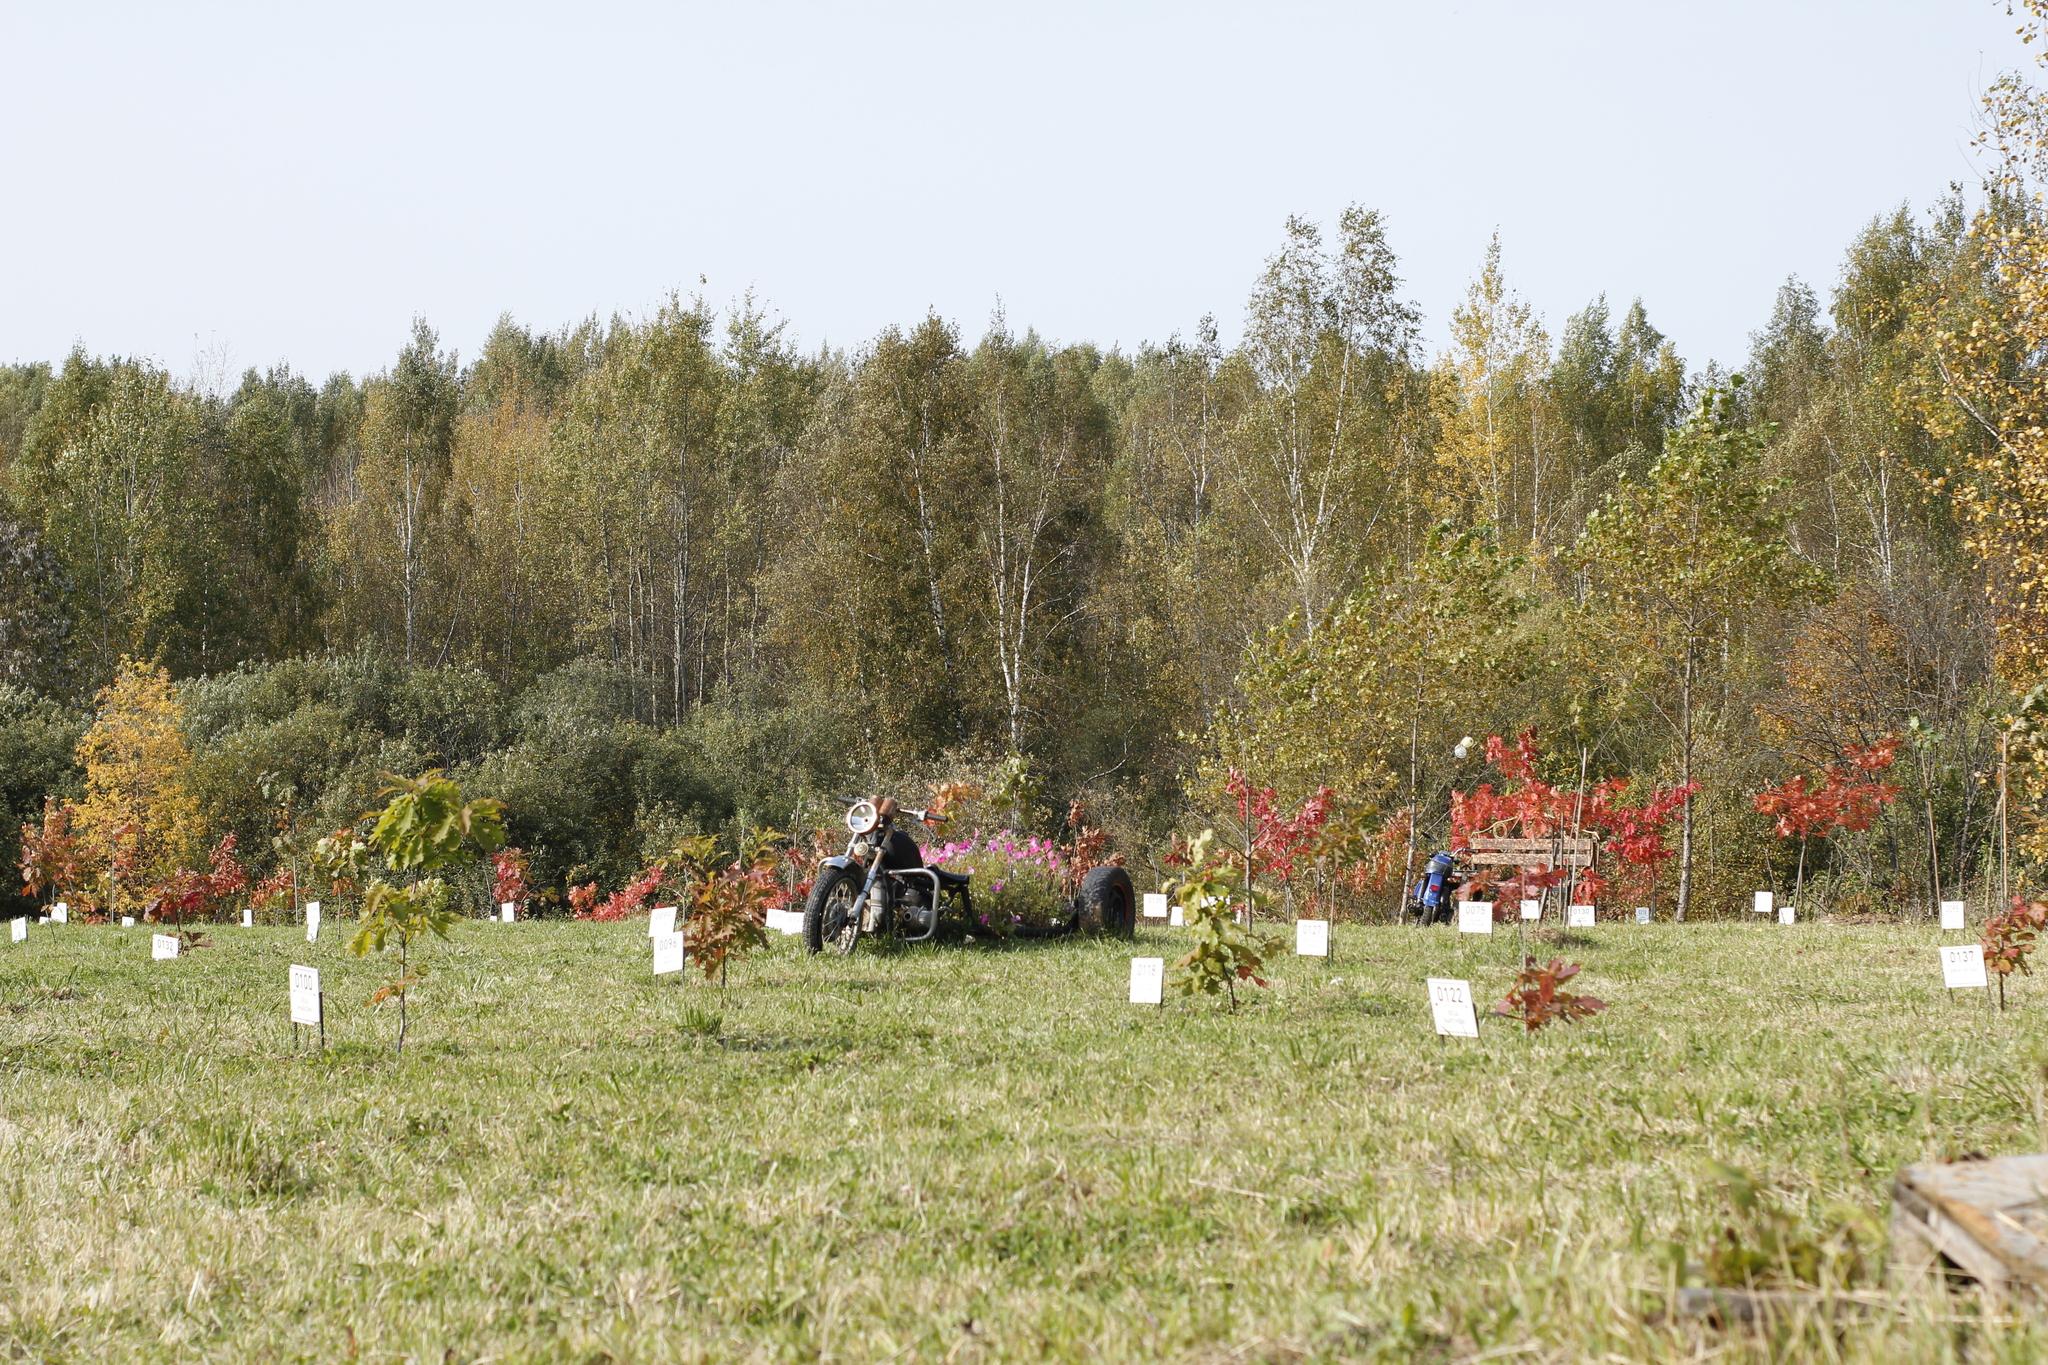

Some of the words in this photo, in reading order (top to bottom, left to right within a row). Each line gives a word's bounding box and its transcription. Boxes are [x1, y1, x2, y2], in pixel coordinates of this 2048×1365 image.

[1465, 905, 1486, 915] 0075
[1303, 924, 1322, 935] 0127
[157, 939, 174, 952] 0132
[659, 938, 678, 951] 0096
[1950, 950, 1974, 963] 0137
[1137, 964, 1156, 976] 0118
[294, 972, 313, 991] 0100
[1436, 986, 1464, 1003] 0122
